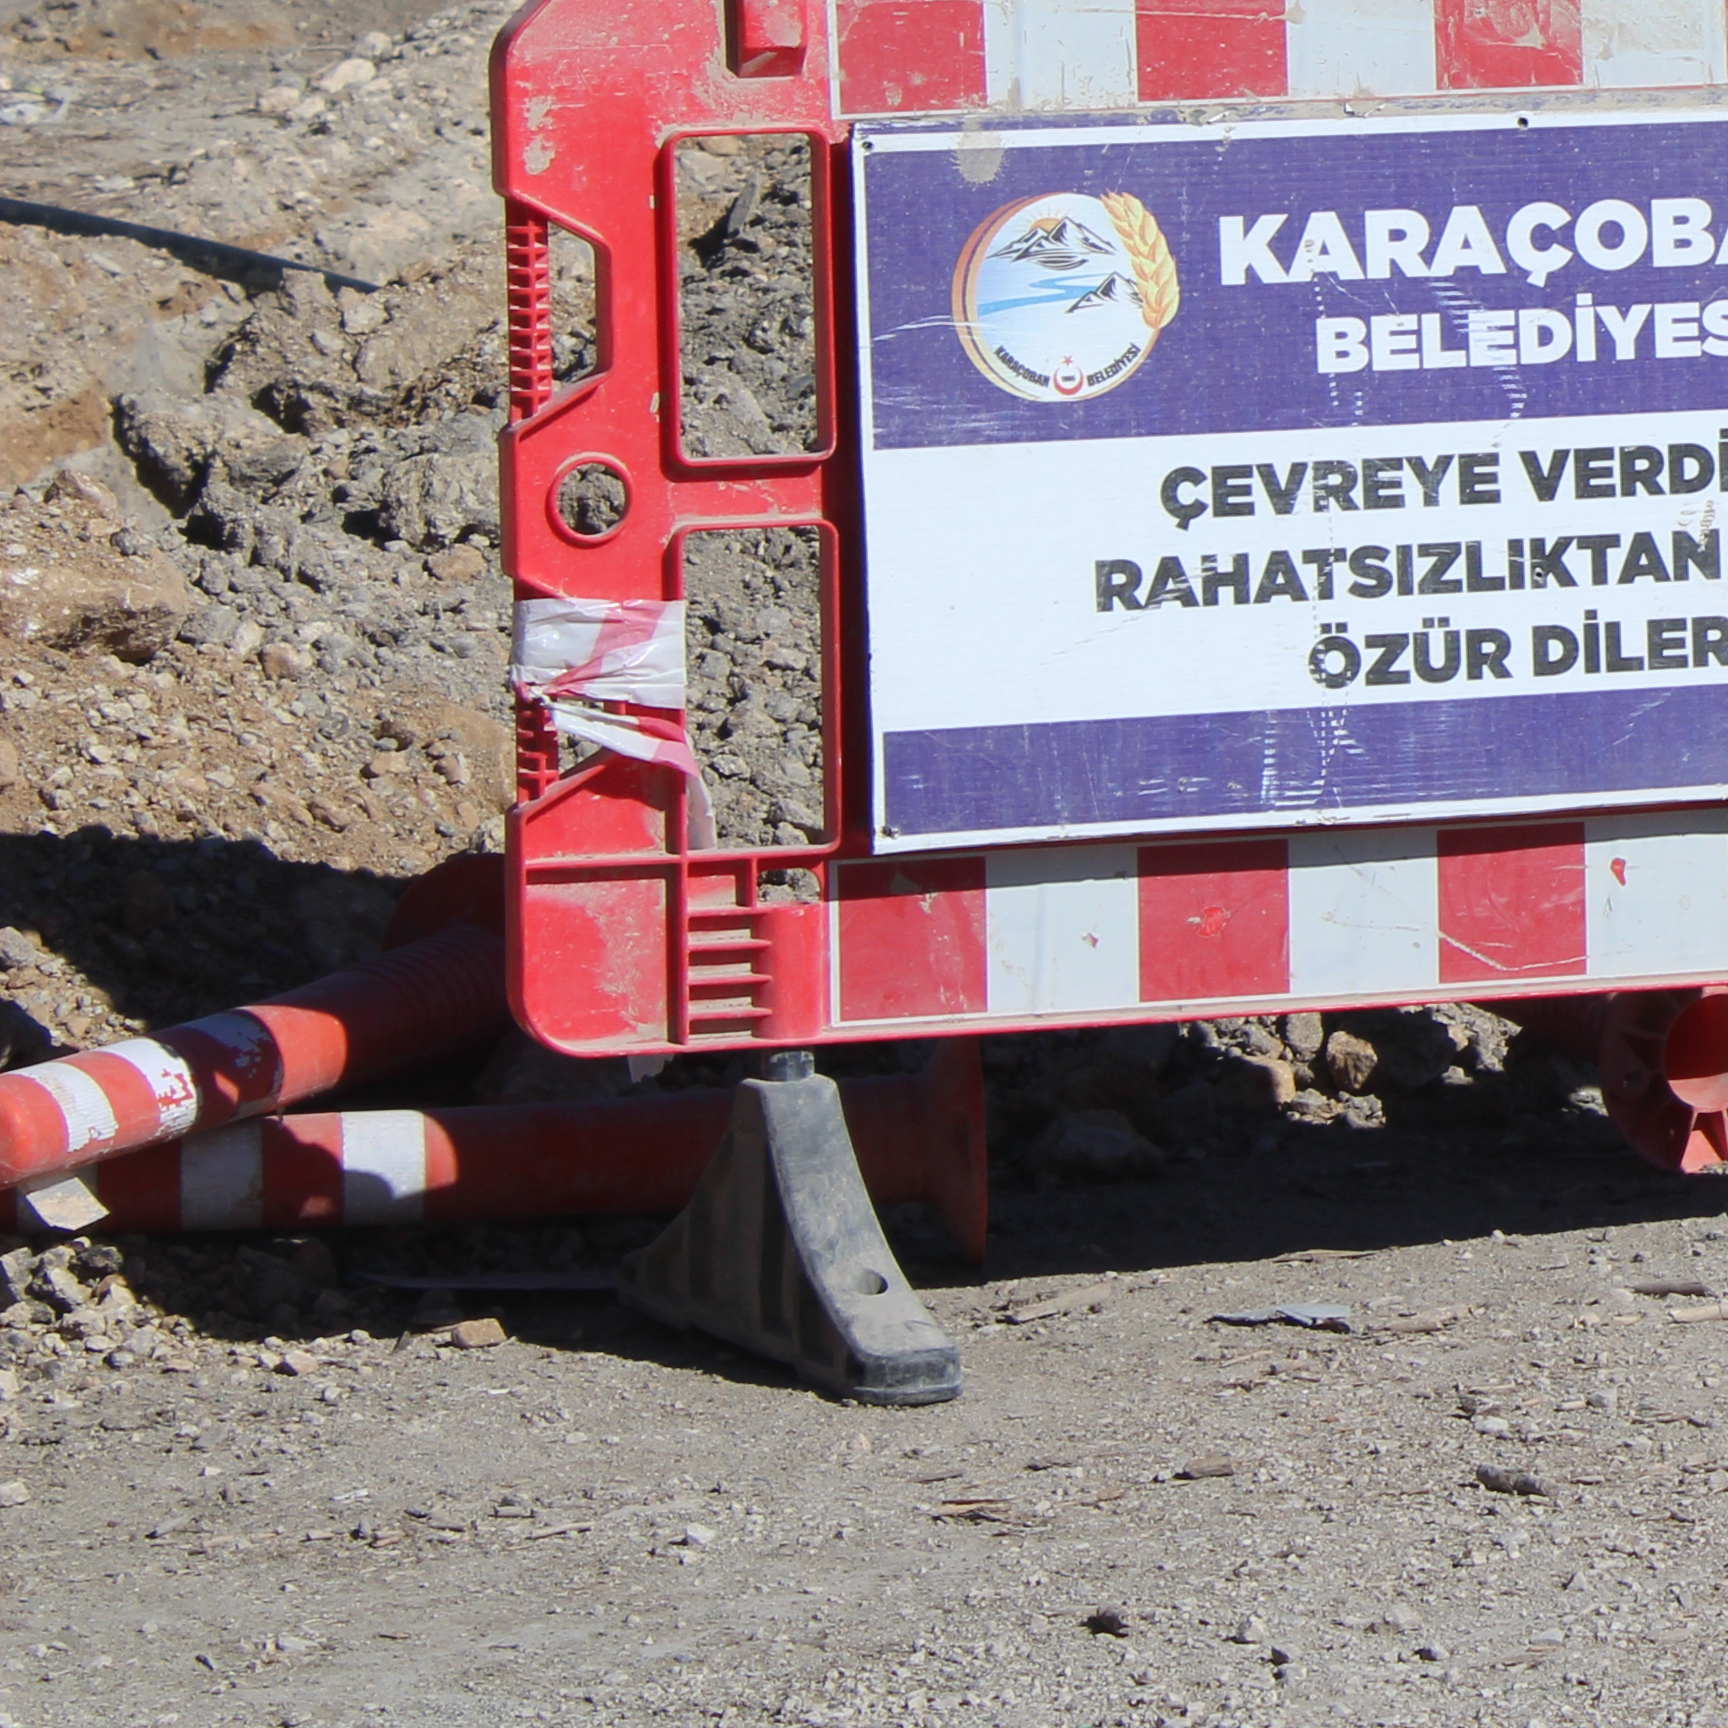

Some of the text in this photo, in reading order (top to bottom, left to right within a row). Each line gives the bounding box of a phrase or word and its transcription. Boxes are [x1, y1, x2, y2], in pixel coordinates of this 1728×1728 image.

[993, 345, 1050, 387] KARAÇOBAN
[1159, 452, 1502, 531] ÇEVREYE
[1094, 527, 1721, 613] RAHATSIZLIKTAN
[1307, 616, 1512, 689] ÖZÜR
